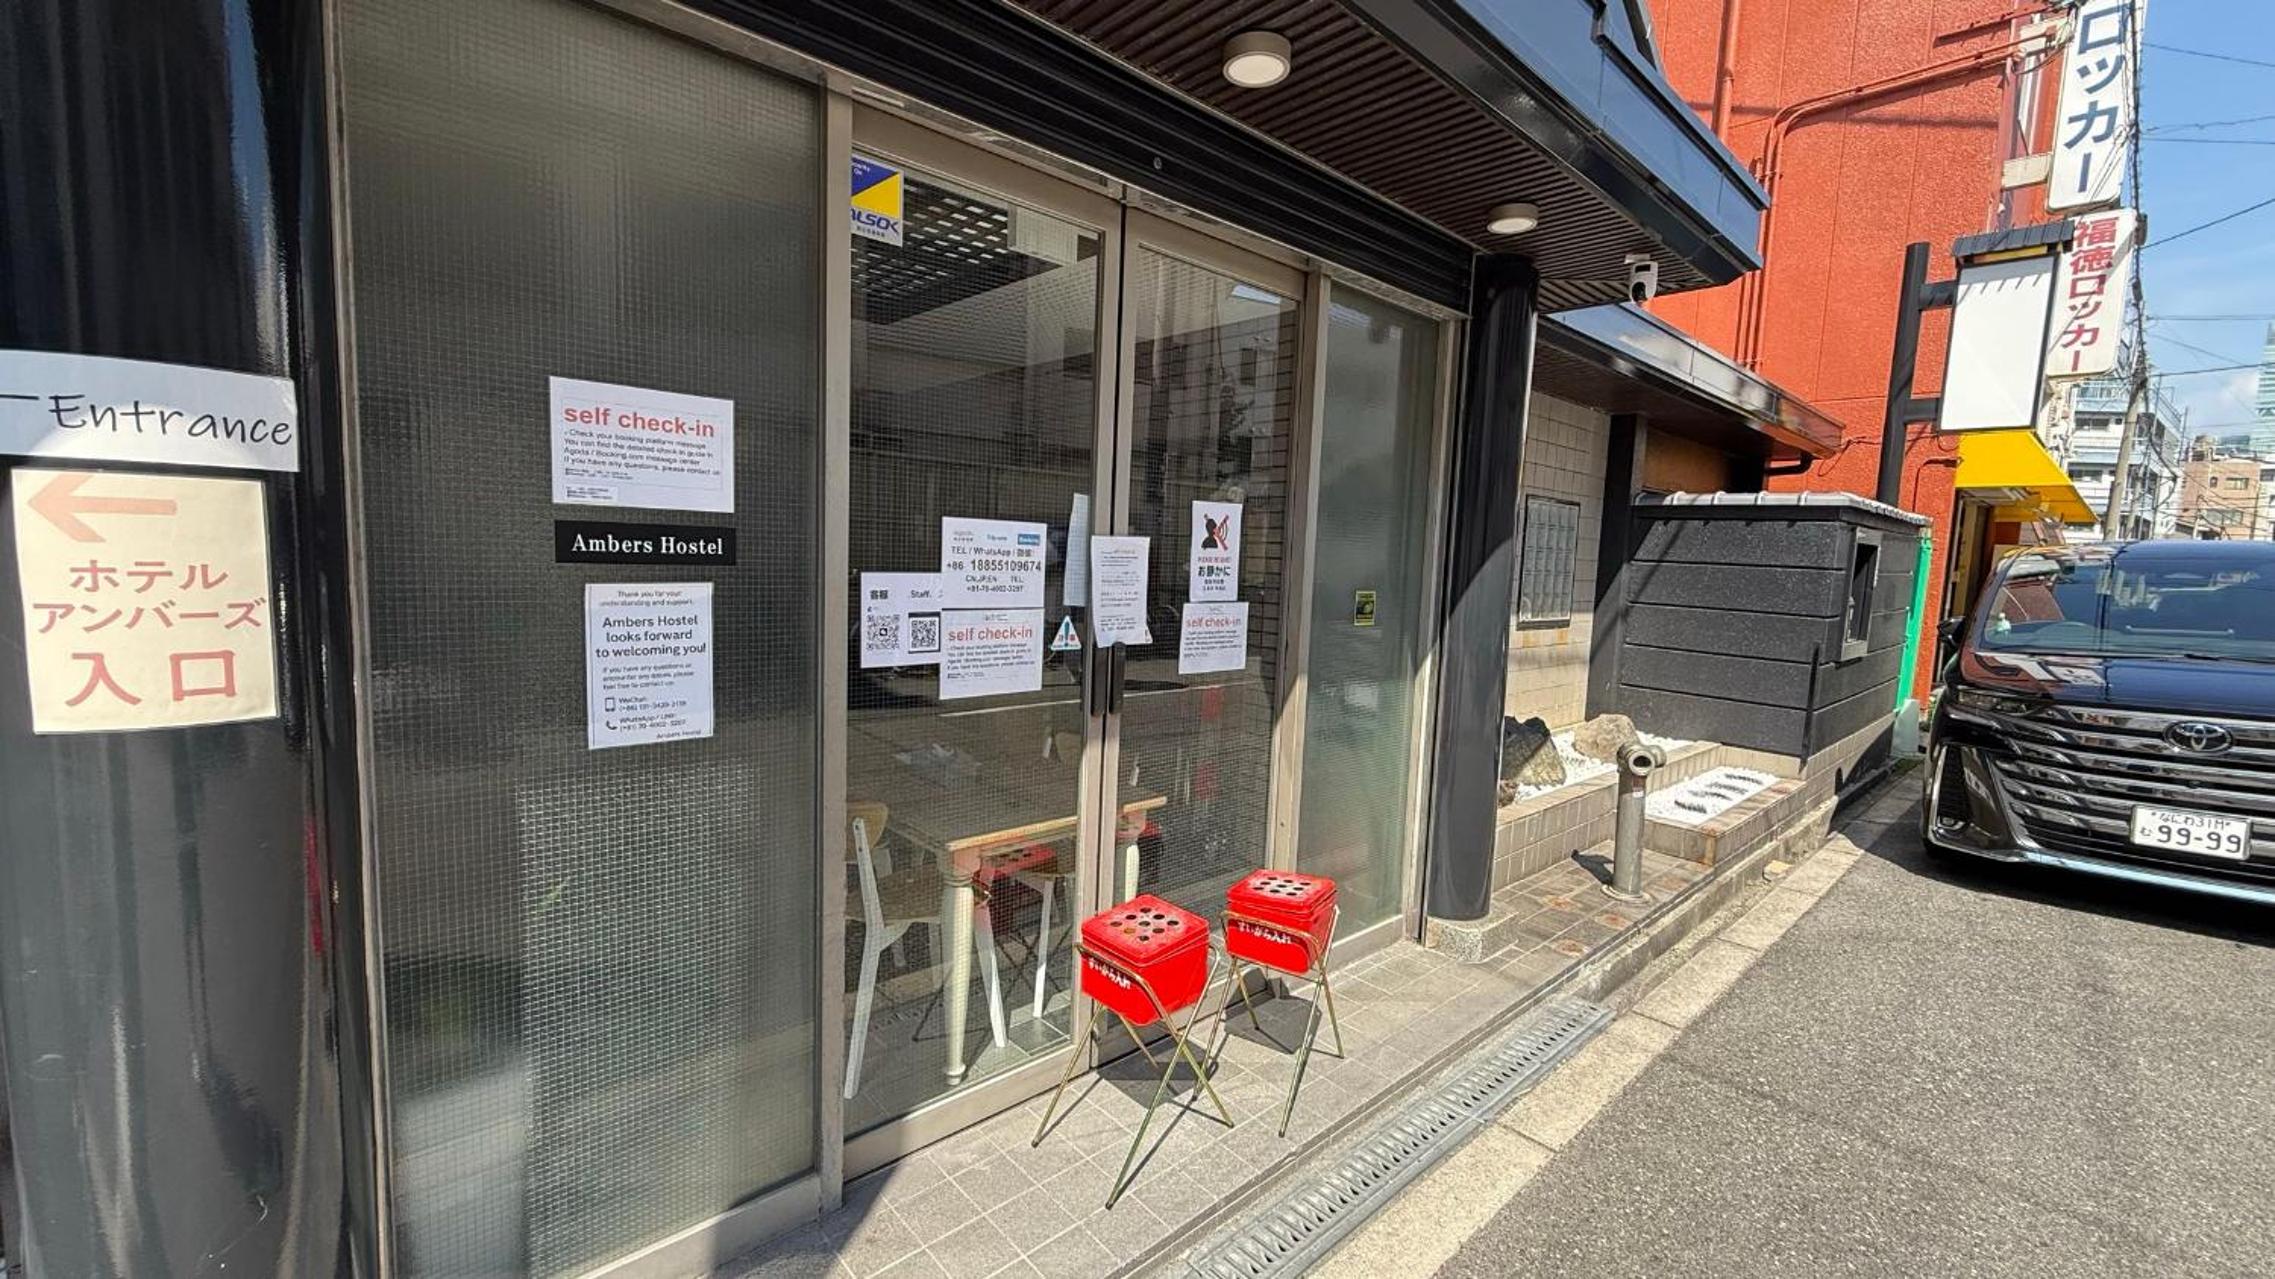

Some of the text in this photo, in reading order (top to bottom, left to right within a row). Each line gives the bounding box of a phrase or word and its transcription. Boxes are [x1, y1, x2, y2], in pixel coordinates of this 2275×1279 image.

[2064, 6, 2128, 193] ロッカー
[2061, 217, 2119, 372] 福徳ロッカー
[48, 394, 292, 446] Entrance
[564, 406, 714, 438] self check-in
[572, 533, 723, 556] Ambers Hostel
[952, 546, 967, 554] TEL
[69, 559, 229, 594] ホテル
[947, 559, 1041, 571] +86 18855109674
[33, 597, 266, 634] アンバーズ
[602, 614, 699, 628] Ambers Hostel
[1185, 616, 1241, 628] self check-in
[606, 629, 693, 643] looks forward
[948, 626, 1033, 641] self check-in
[595, 642, 706, 658] to welcoming you!
[65, 648, 237, 707] 入口
[2157, 825, 2242, 853] 99-99
